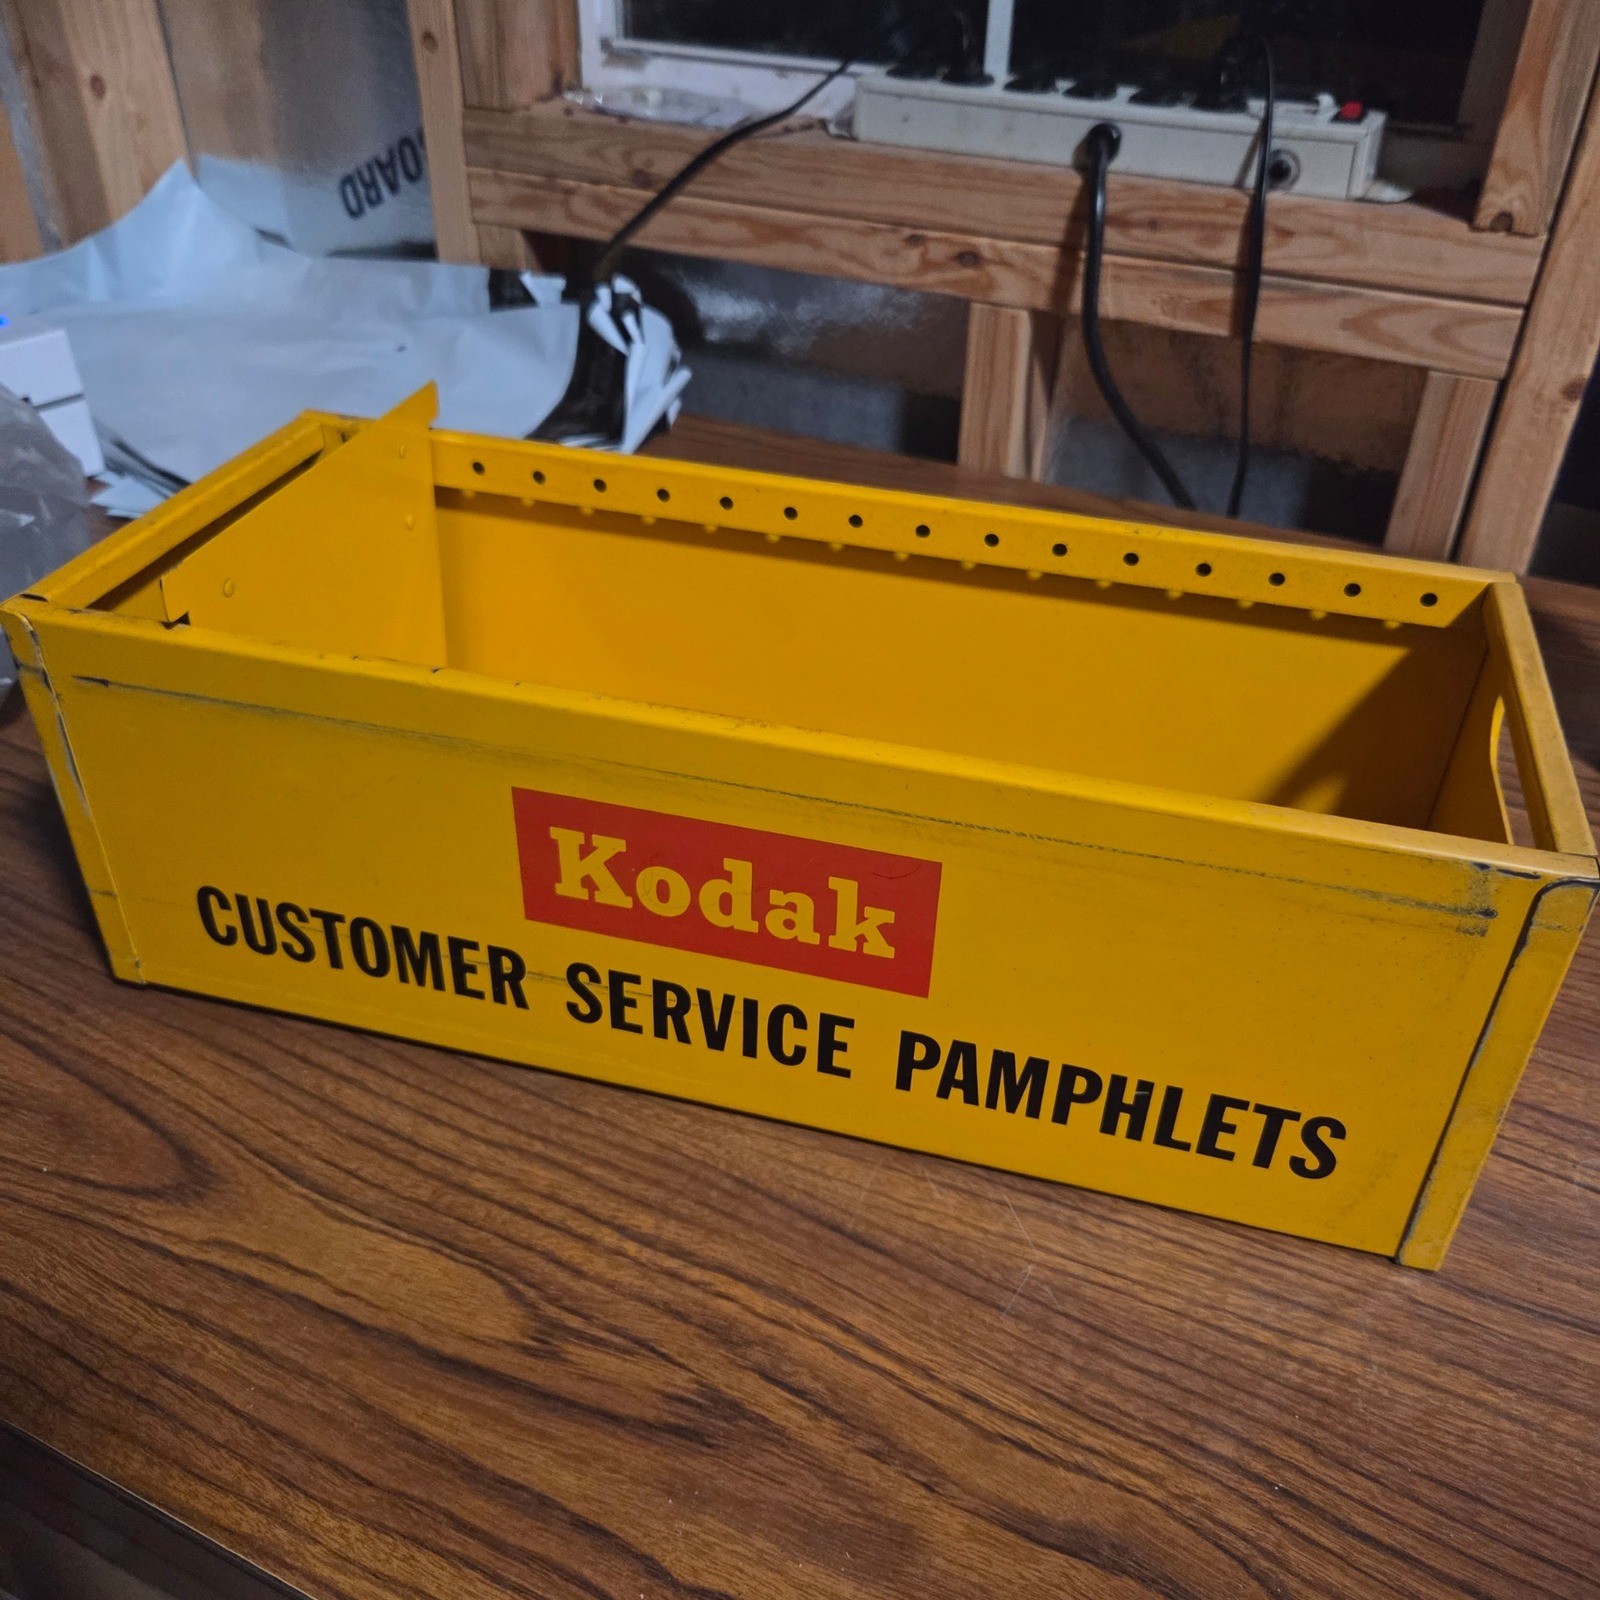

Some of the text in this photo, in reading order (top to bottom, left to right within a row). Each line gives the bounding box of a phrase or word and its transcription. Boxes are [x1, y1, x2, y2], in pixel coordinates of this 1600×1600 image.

[339, 126, 425, 220] OARD
[549, 826, 896, 959] Kodak
[196, 885, 1346, 1180] CUSTOMER SERVICE PAMPHLETS
